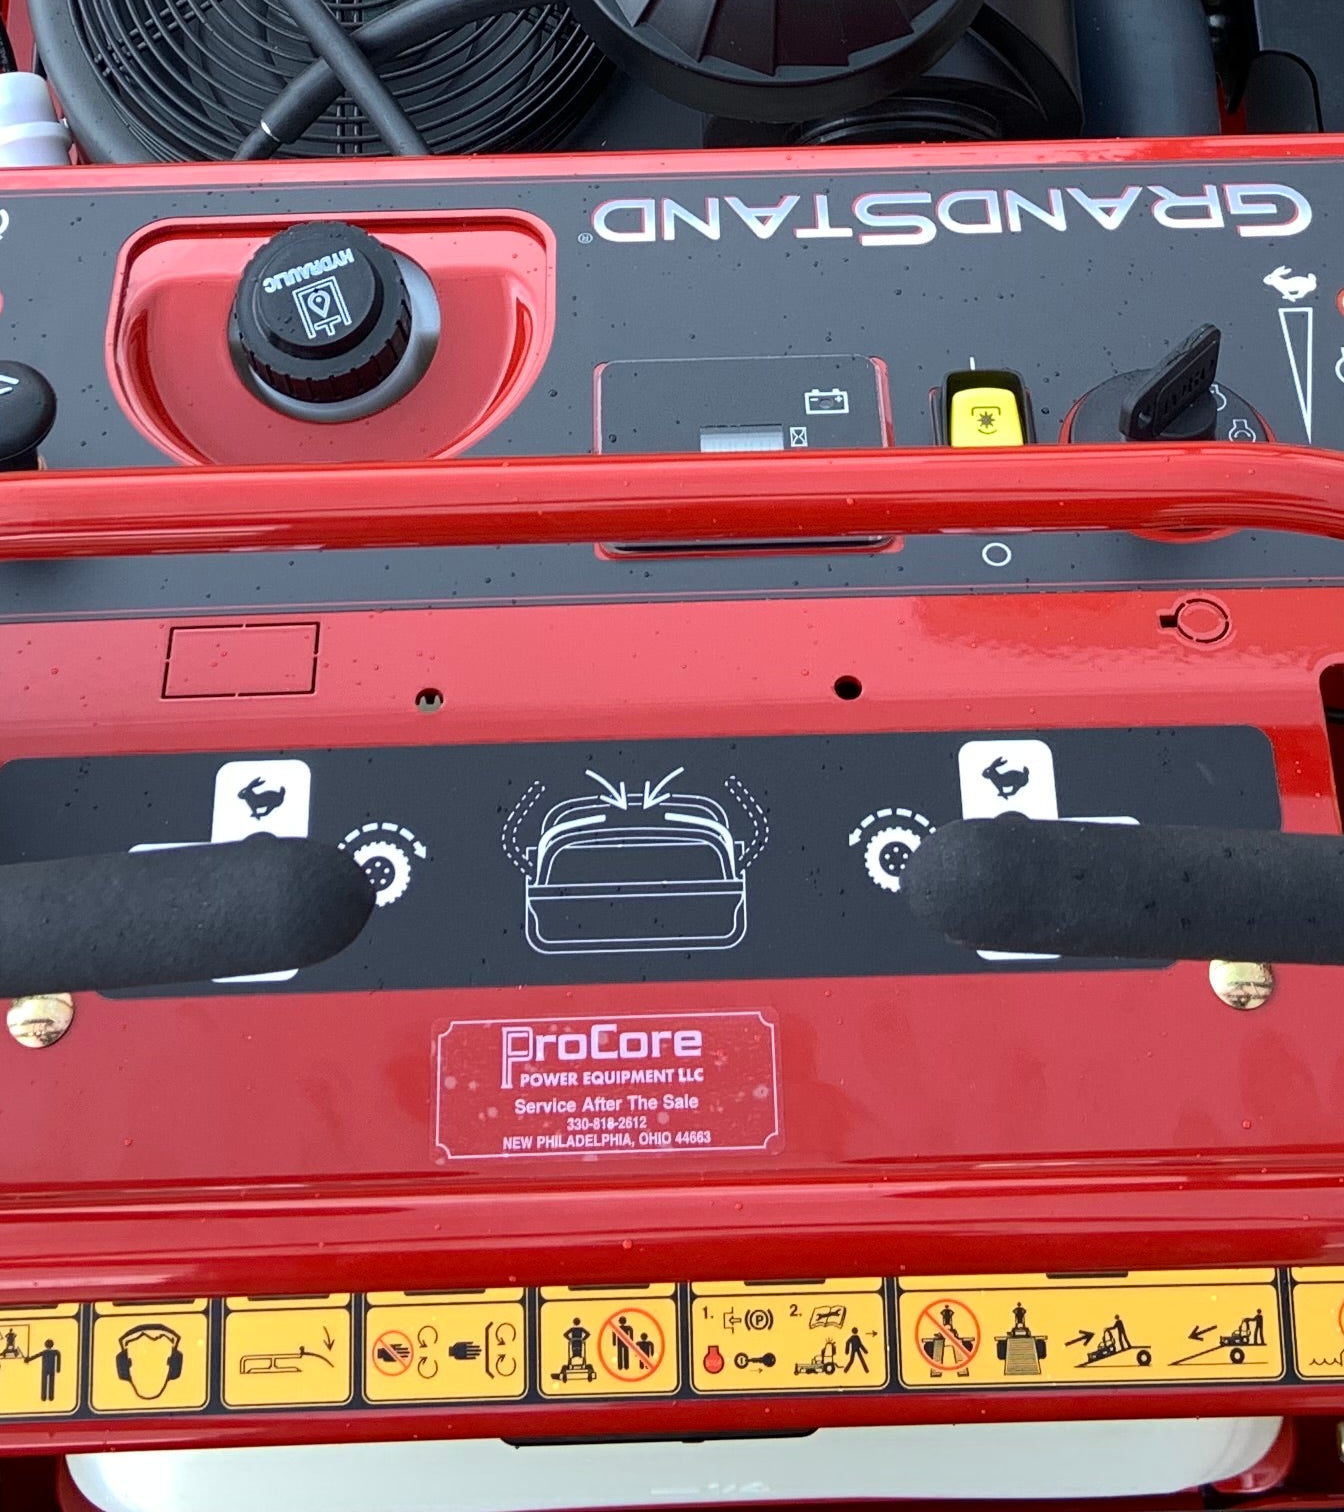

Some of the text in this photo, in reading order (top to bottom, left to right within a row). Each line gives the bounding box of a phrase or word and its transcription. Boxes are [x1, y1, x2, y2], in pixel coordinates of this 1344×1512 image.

[262, 247, 355, 294] HYDRAULIC
[500, 1024, 703, 1089] ProCore
[519, 1068, 704, 1088] POWER EQUIPMENT LLC
[514, 1093, 699, 1115] Service After The Sale
[566, 1116, 647, 1132] 330-818-2612
[503, 1130, 712, 1150] NEW PHILADELPHIA, OHIO 44663
